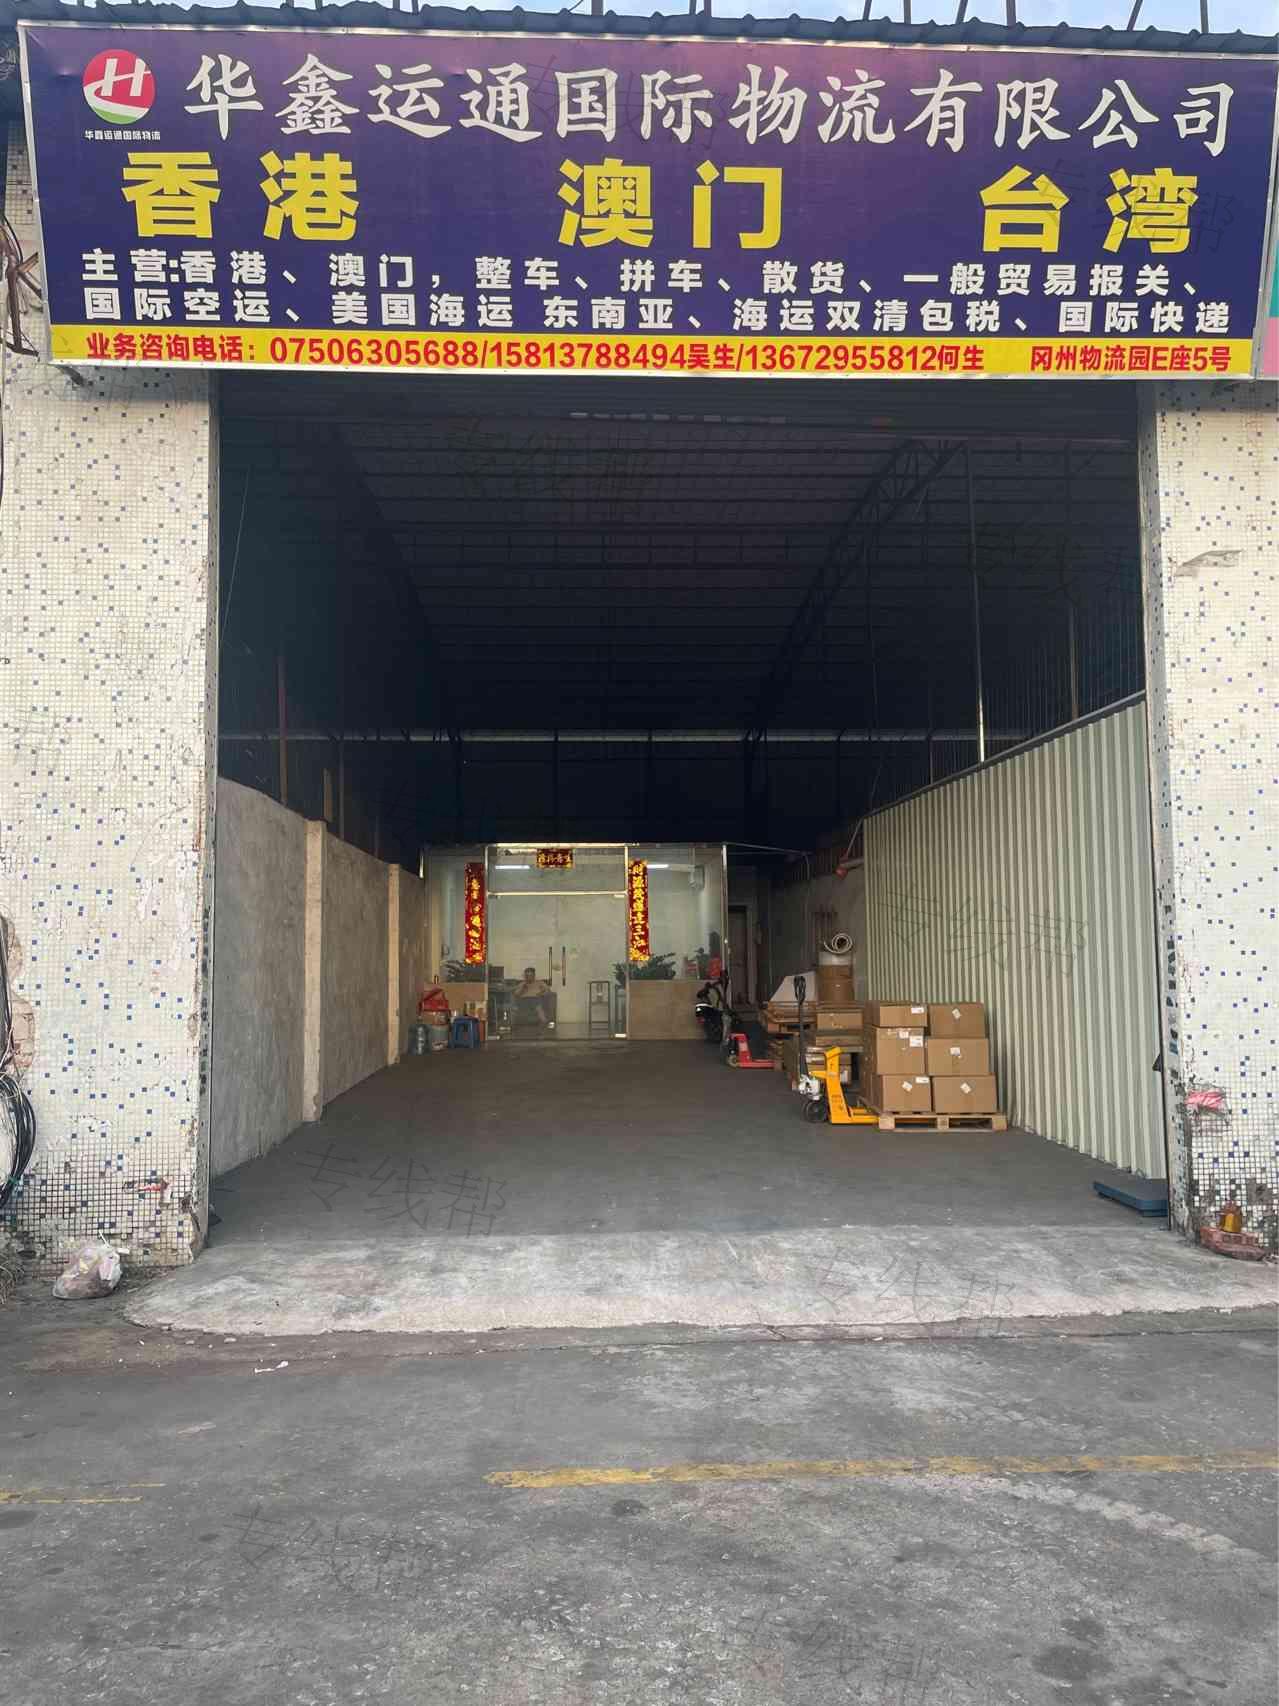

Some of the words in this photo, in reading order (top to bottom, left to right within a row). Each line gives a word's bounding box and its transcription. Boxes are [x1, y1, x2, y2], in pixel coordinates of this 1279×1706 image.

[184, 53, 1235, 157] 华鑫运通国际物流有限公司
[122, 150, 360, 241] 香港
[558, 158, 784, 250] 澳门
[979, 165, 1199, 254] 台湾
[1031, 345, 1232, 372] 冈州物流园E座5号
